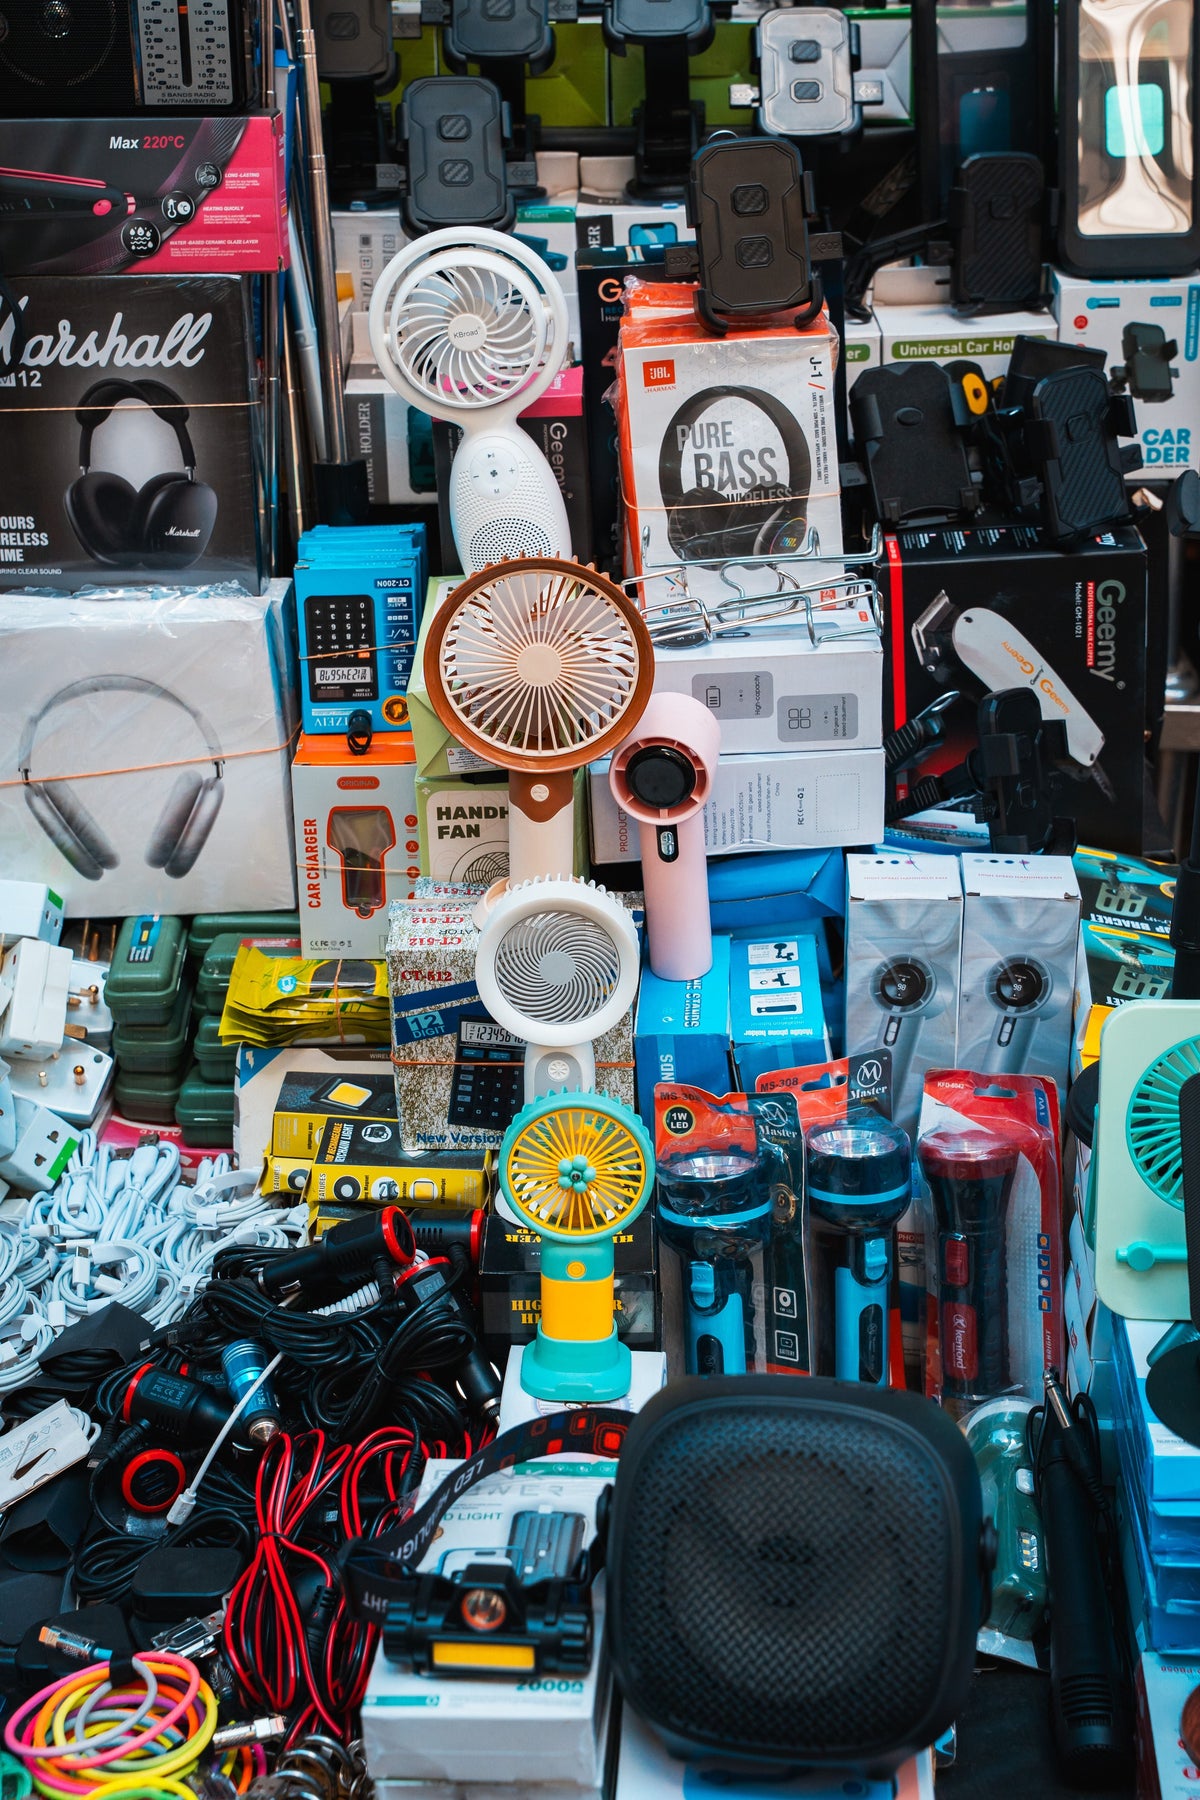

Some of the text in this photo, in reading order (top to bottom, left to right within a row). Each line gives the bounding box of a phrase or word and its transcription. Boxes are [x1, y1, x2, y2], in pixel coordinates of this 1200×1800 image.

[109, 135, 185, 150] Max 220°C
[453, 329, 479, 339] KBroad
[889, 342, 953, 357] Universal
[956, 341, 979, 353] Car
[649, 366, 671, 380] JBL
[809, 356, 823, 378] J-1
[358, 402, 372, 454] HOLDER
[676, 420, 735, 452] PURE
[1142, 428, 1191, 447] CAR
[693, 447, 779, 492] BASS
[0, 532, 49, 547] RELESS
[165, 526, 201, 538] Marshall
[376, 579, 410, 587] CT-200N
[670, 606, 690, 614] Bluetoo
[1075, 581, 1083, 638] Model: GM-1021
[1089, 579, 1126, 681] Geemy
[754, 674, 762, 716] High-capacity
[1039, 678, 1070, 714] Geemy
[437, 823, 481, 840] FAN
[303, 818, 321, 909] CAR CHARGER
[411, 916, 465, 925] CT-512
[1090, 913, 1152, 932] BRACKET
[408, 937, 463, 947] CT-512
[400, 969, 453, 982] CT-512
[691, 993, 702, 1028] STANDS
[410, 1013, 440, 1032] 12
[412, 1025, 446, 1039] DIGIT
[760, 1078, 799, 1093] MS-308
[850, 1085, 889, 1100] Master
[937, 1081, 965, 1090] KFD-6042
[671, 1112, 688, 1121] 1W
[341, 1123, 354, 1140] LIGHT
[670, 1121, 689, 1129] LED
[759, 1124, 798, 1139] Master
[416, 1132, 505, 1144] New Version
[955, 1329, 967, 1369] kenford
[454, 1458, 485, 1493] LED
[457, 1512, 504, 1522] LIGHT
